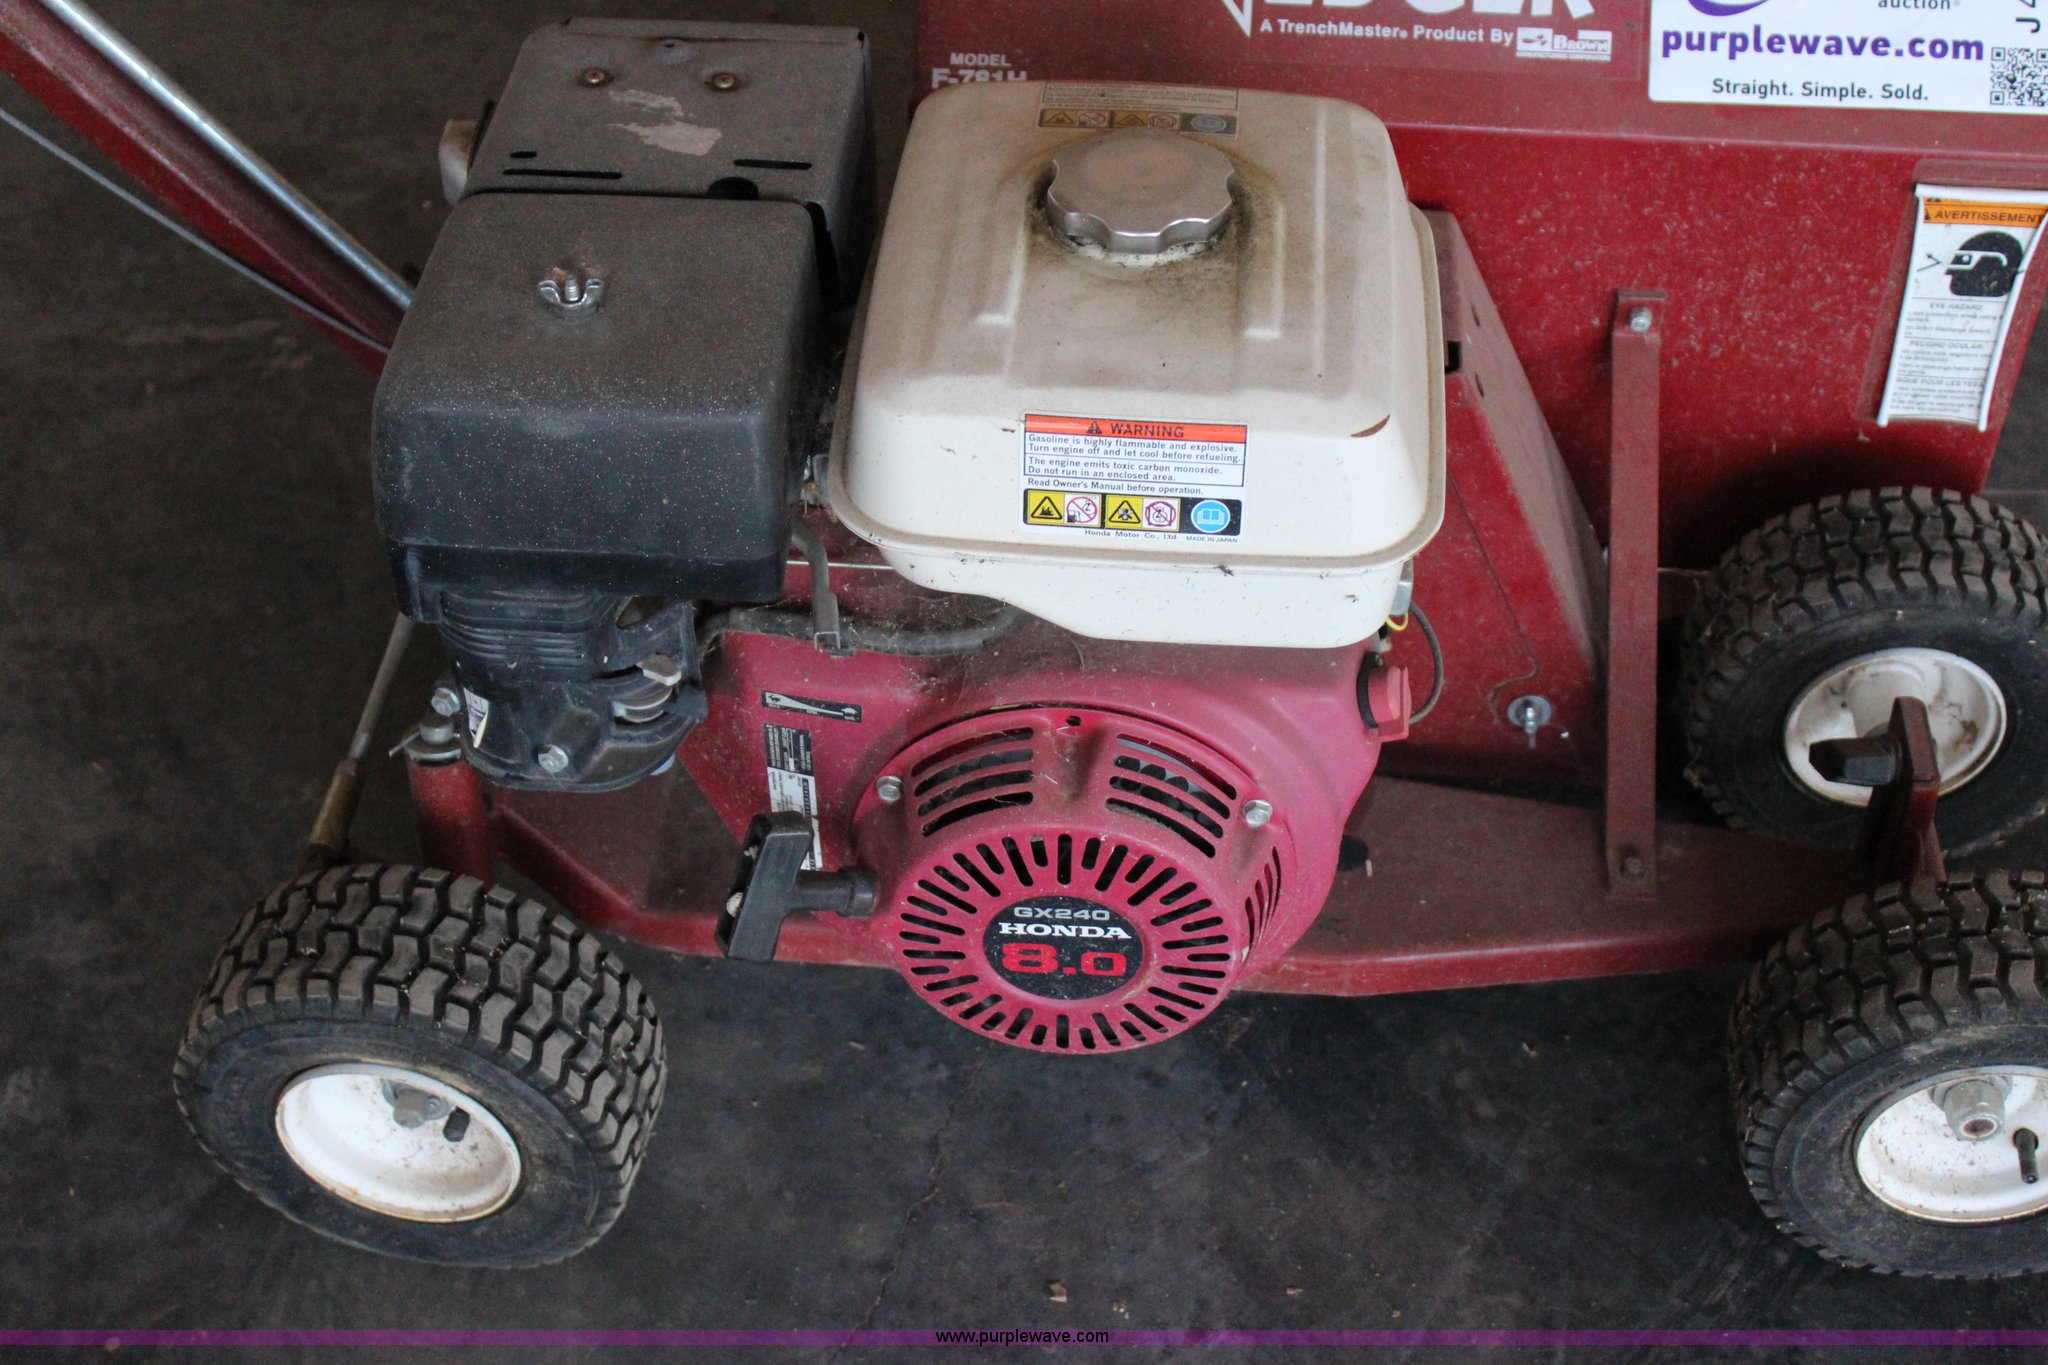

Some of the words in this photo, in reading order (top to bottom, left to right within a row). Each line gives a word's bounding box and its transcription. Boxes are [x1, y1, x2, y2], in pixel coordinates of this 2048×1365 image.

[1259, 18, 1273, 32] A
[1413, 24, 1484, 43] Product
[1490, 28, 1514, 47] By
[1661, 24, 1984, 61] purplewave.com
[950, 52, 1011, 67] MODEL
[1711, 78, 1794, 98] Straight.
[1801, 81, 1874, 102] Simple.
[1881, 83, 1929, 101] Sold.
[1111, 422, 1185, 438] WARNING
[1028, 433, 1069, 444] Gasoline
[1072, 436, 1080, 444] is
[1084, 436, 1112, 448] highly
[1115, 438, 1166, 449] flammable
[1169, 442, 1187, 450] and
[1190, 442, 1238, 453] explosive.
[1029, 443, 1049, 452] Turn
[1052, 445, 1084, 455] engine
[1087, 446, 1100, 455] off
[1103, 448, 1120, 456] and
[1124, 448, 1136, 457] let
[1139, 450, 1159, 458] cool
[1162, 450, 1192, 460] before
[1195, 453, 1241, 464] refueling.
[1028, 465, 1040, 474] Do
[1043, 467, 1059, 475] not
[1061, 468, 1077, 476] run
[1093, 470, 1104, 478] an
[1107, 471, 1149, 480] enclosed
[1152, 473, 1176, 481] area.
[1029, 456, 1046, 465] The
[1049, 459, 1080, 468] engine
[1084, 460, 1110, 469] emits
[1113, 461, 1135, 470] toxic
[1138, 463, 1171, 472] carbon
[1174, 465, 1223, 475] monoxide.
[1027, 478, 1050, 488] Read
[1053, 479, 1088, 489] Owner's
[1091, 481, 1124, 491] Manual
[1127, 483, 1156, 493] before
[1158, 485, 1204, 495] operation.
[1084, 529, 1111, 537] Honda
[1115, 530, 1140, 539] Motor
[1216, 536, 1239, 544] JAPAN
[1013, 906, 1110, 921] GX240
[998, 922, 1132, 939] HONDA
[1002, 942, 1127, 976] 8.0
